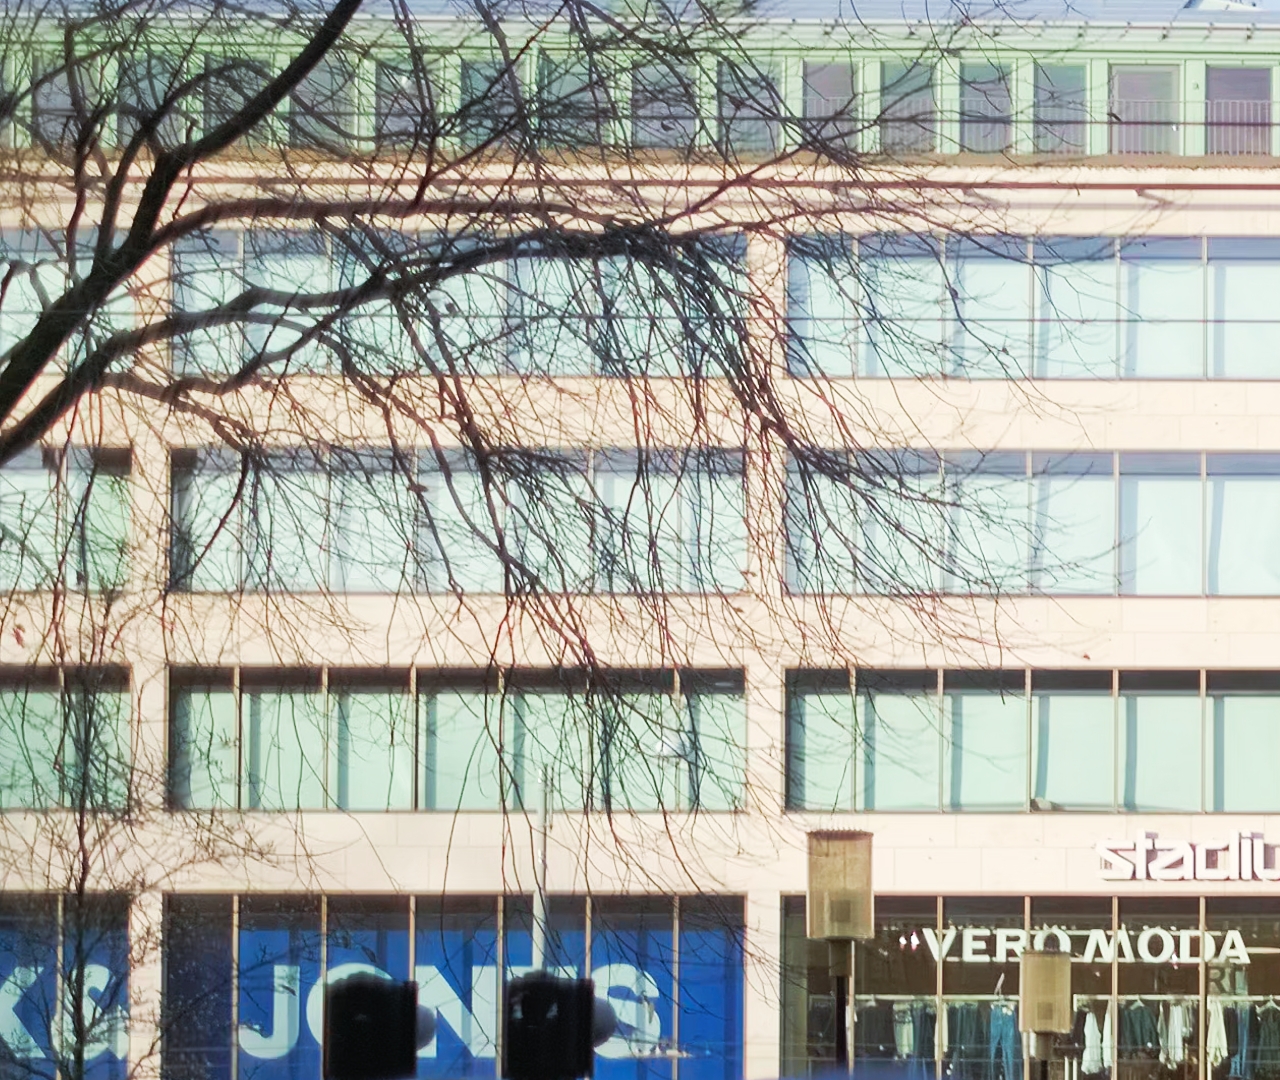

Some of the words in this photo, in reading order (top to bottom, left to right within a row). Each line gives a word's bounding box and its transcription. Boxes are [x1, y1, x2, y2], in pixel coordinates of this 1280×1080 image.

[922, 927, 1071, 962] VERO
[1083, 927, 1251, 963] MODA
[238, 963, 661, 1059] JNS
